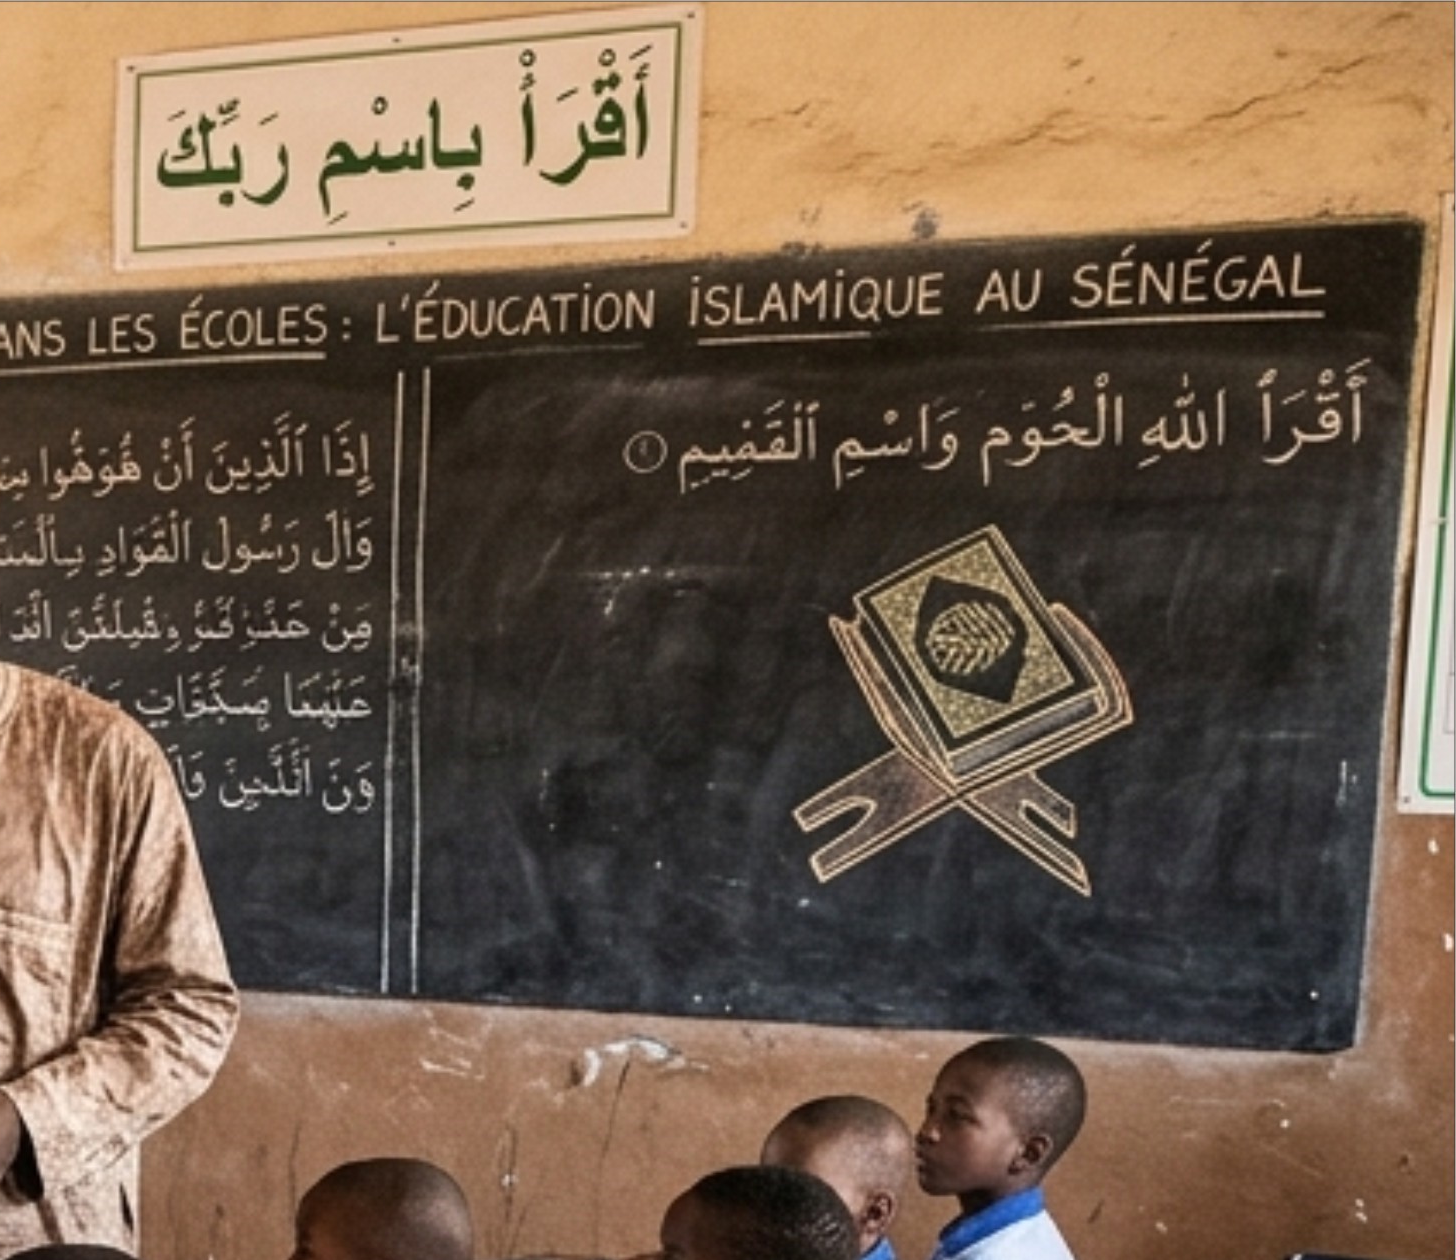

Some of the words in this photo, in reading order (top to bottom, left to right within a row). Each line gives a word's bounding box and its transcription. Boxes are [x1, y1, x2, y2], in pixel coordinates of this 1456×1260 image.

[88, 312, 156, 357] LES
[179, 294, 328, 352] ÉCOLES
[975, 268, 1043, 315] AU
[1070, 237, 1327, 310] SÉNÉGAL
